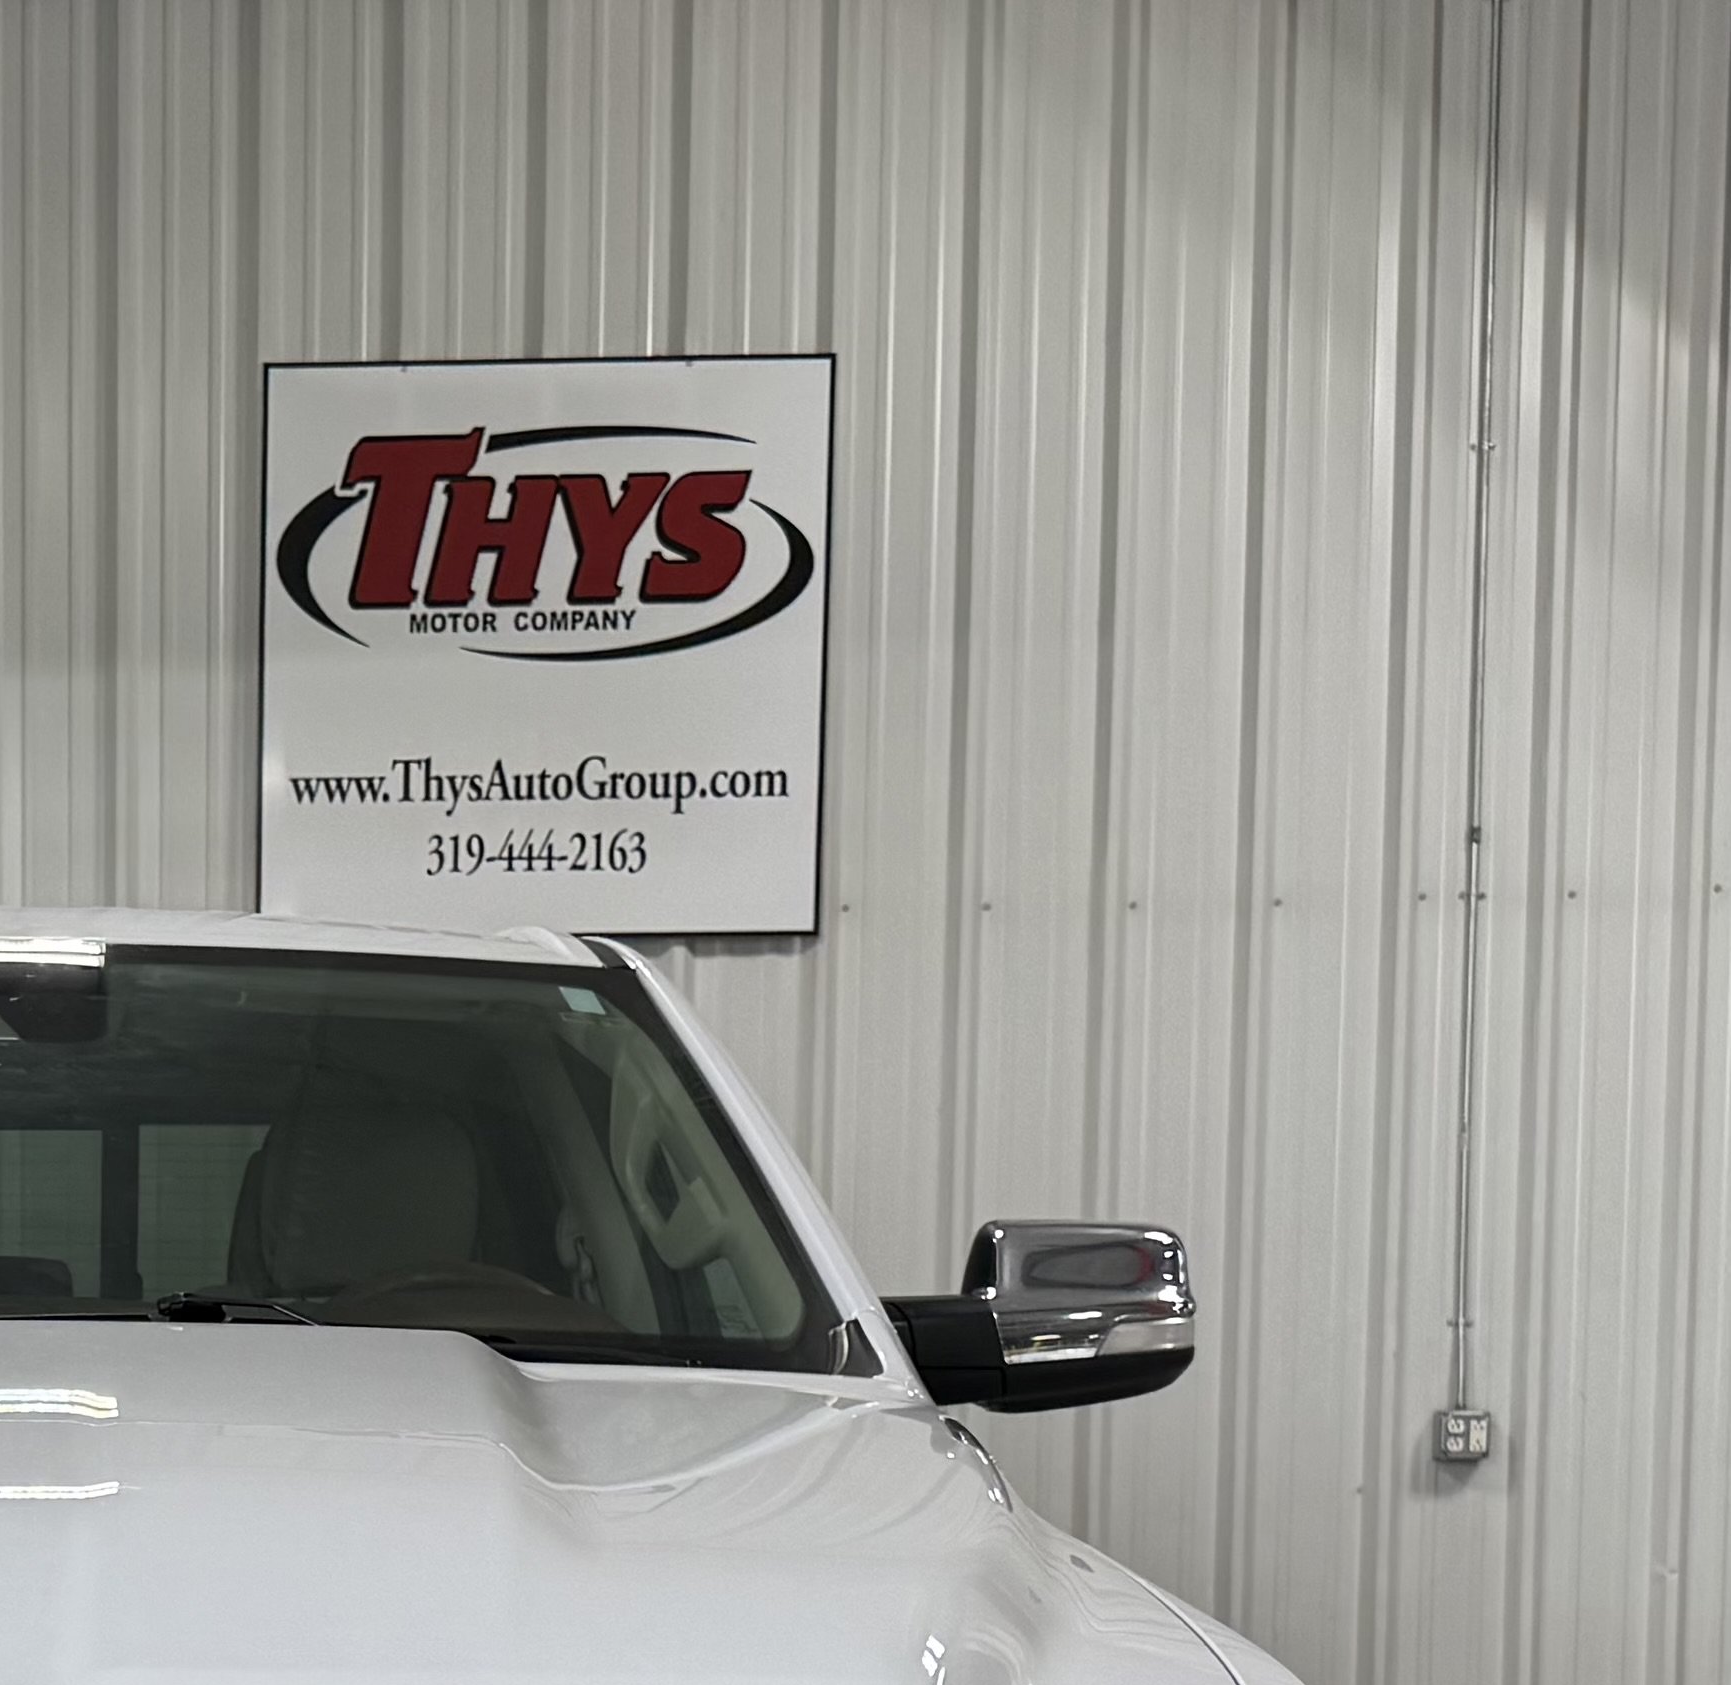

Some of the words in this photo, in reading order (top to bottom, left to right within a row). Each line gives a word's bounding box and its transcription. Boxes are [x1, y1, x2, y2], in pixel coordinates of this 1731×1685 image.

[342, 427, 752, 609] THYS
[409, 611, 497, 634] MOTOR
[514, 609, 637, 632] COMPANY
[289, 756, 790, 816] www.ThysAutoGroup.com
[426, 828, 648, 876] 319-444-2163
